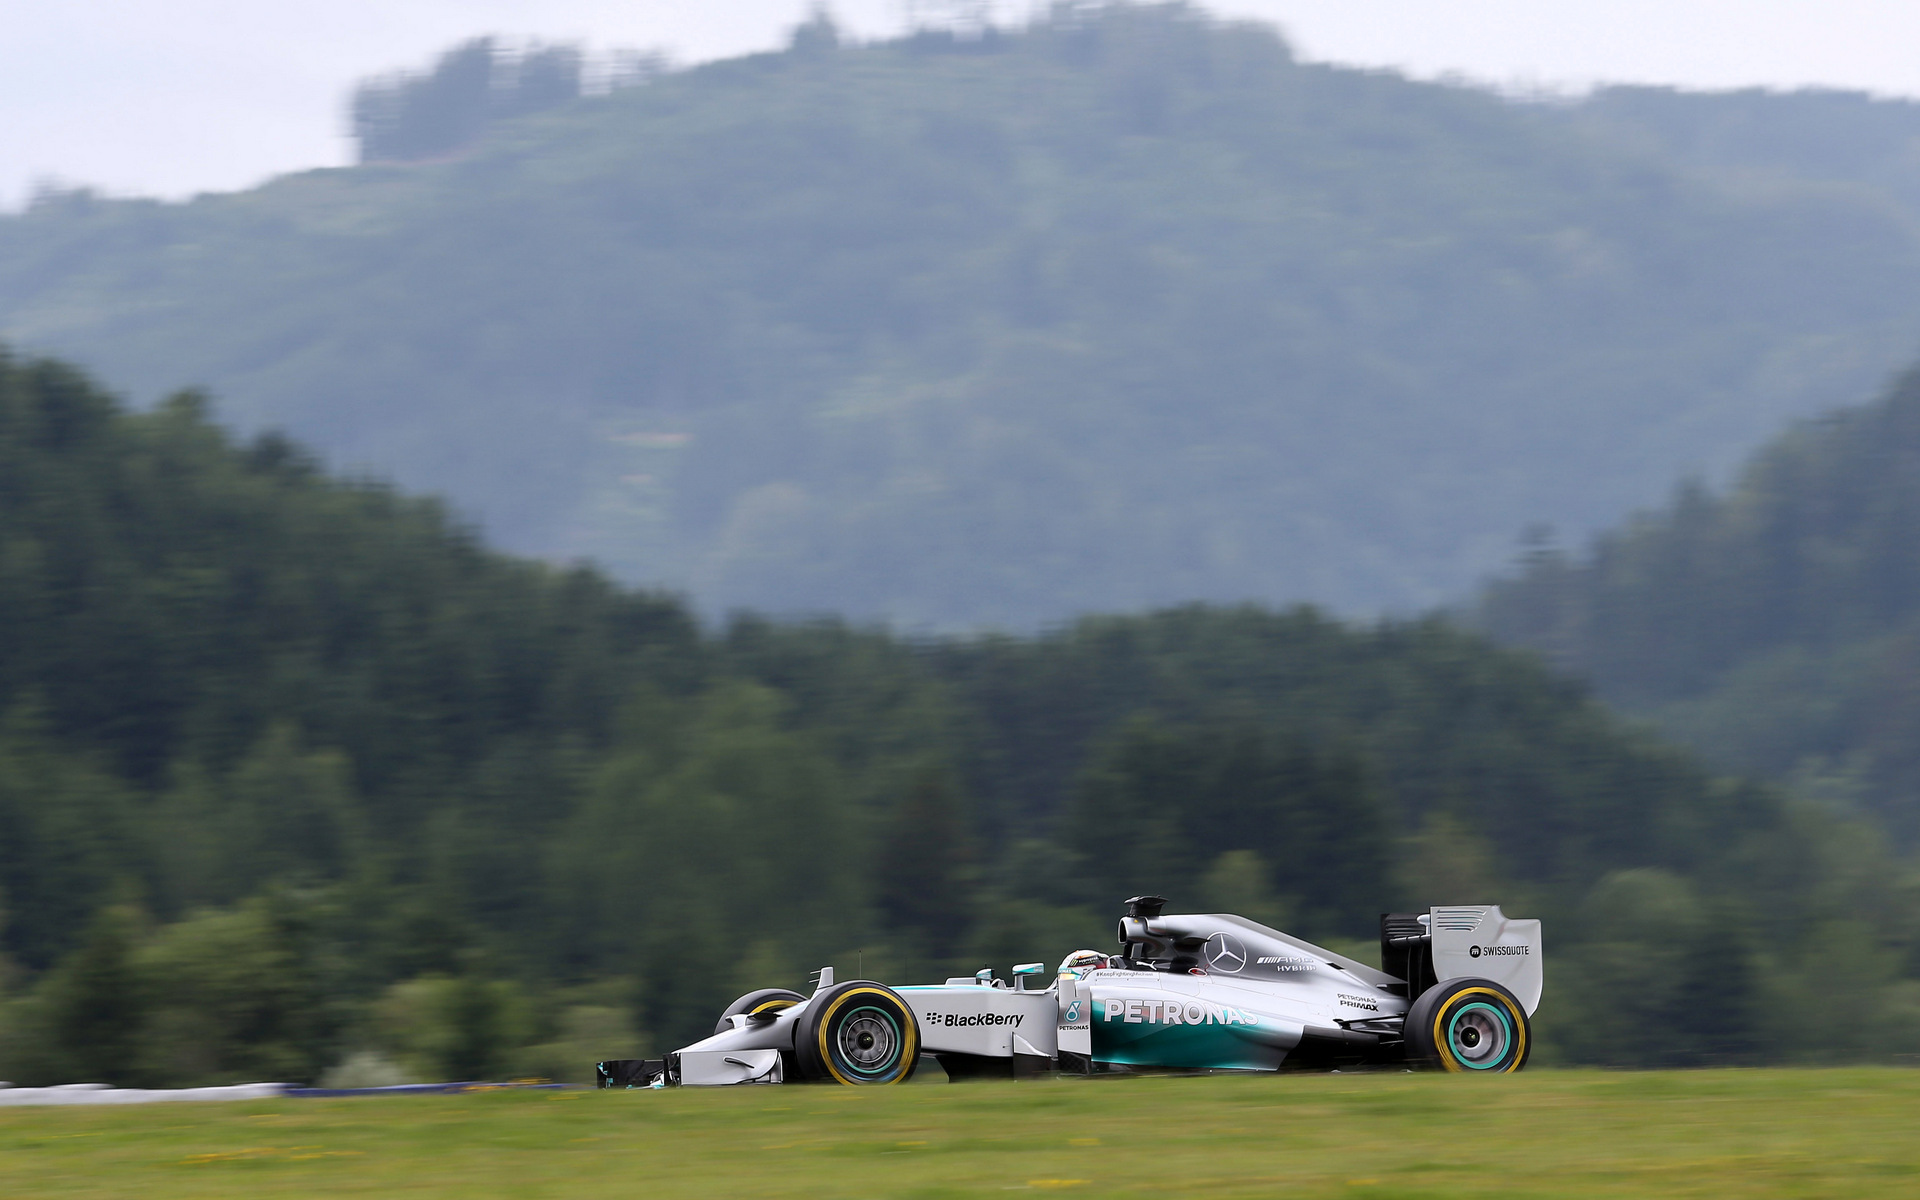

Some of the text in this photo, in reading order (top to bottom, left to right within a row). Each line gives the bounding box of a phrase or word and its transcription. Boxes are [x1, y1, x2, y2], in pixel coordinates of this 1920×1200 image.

[1483, 945, 1529, 956] SWISSQUOTE
[1337, 993, 1377, 1003] PETRONAS
[1104, 998, 1259, 1026] PETRONAS
[1340, 1000, 1379, 1012] PRIMAX
[944, 1013, 1024, 1028] BlackBerry
